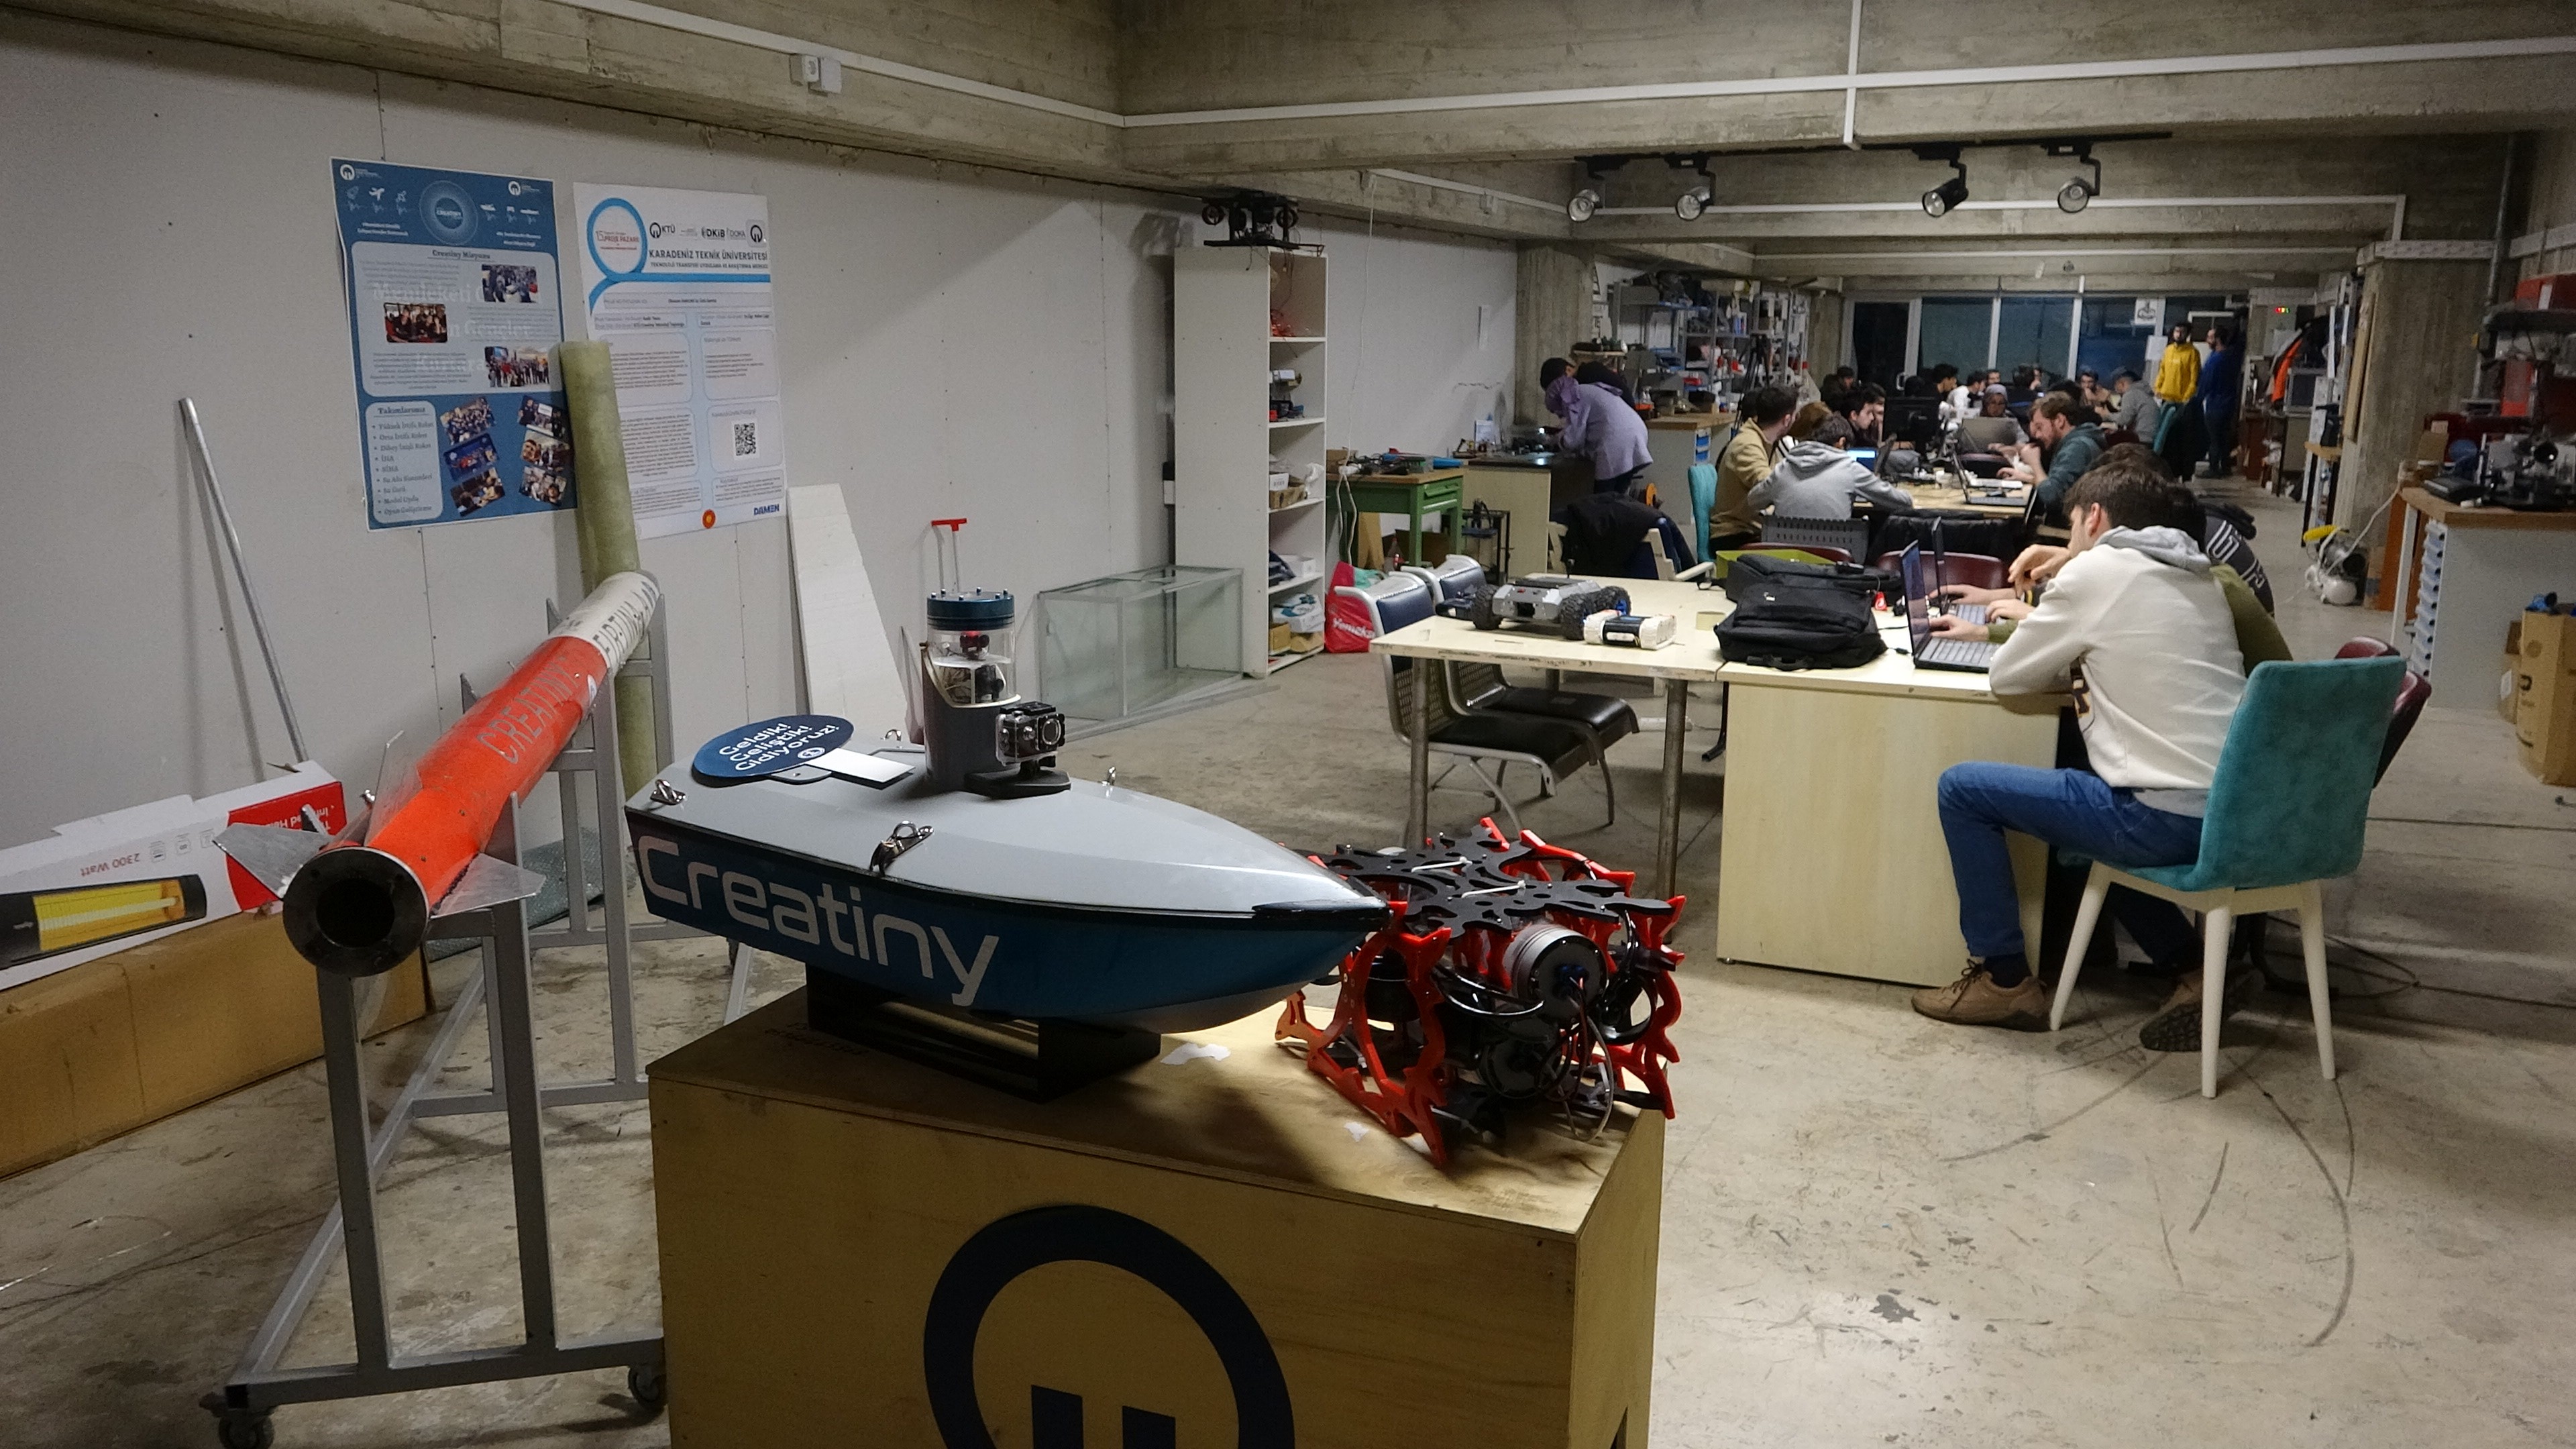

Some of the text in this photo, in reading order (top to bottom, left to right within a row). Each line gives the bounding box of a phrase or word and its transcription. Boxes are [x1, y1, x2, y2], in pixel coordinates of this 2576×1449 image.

[661, 224, 676, 233] KTÜ
[649, 248, 768, 260] KARADENİZ TEKNİK ÜNİVERSİTESİ
[476, 661, 580, 765] CREATINY
[719, 723, 791, 755] Geldik!
[730, 725, 812, 761] Geliştik!
[735, 724, 839, 770] Gidiyoruz!
[80, 853, 140, 877] 2300 Watt
[639, 835, 1000, 1006] Creatiny
